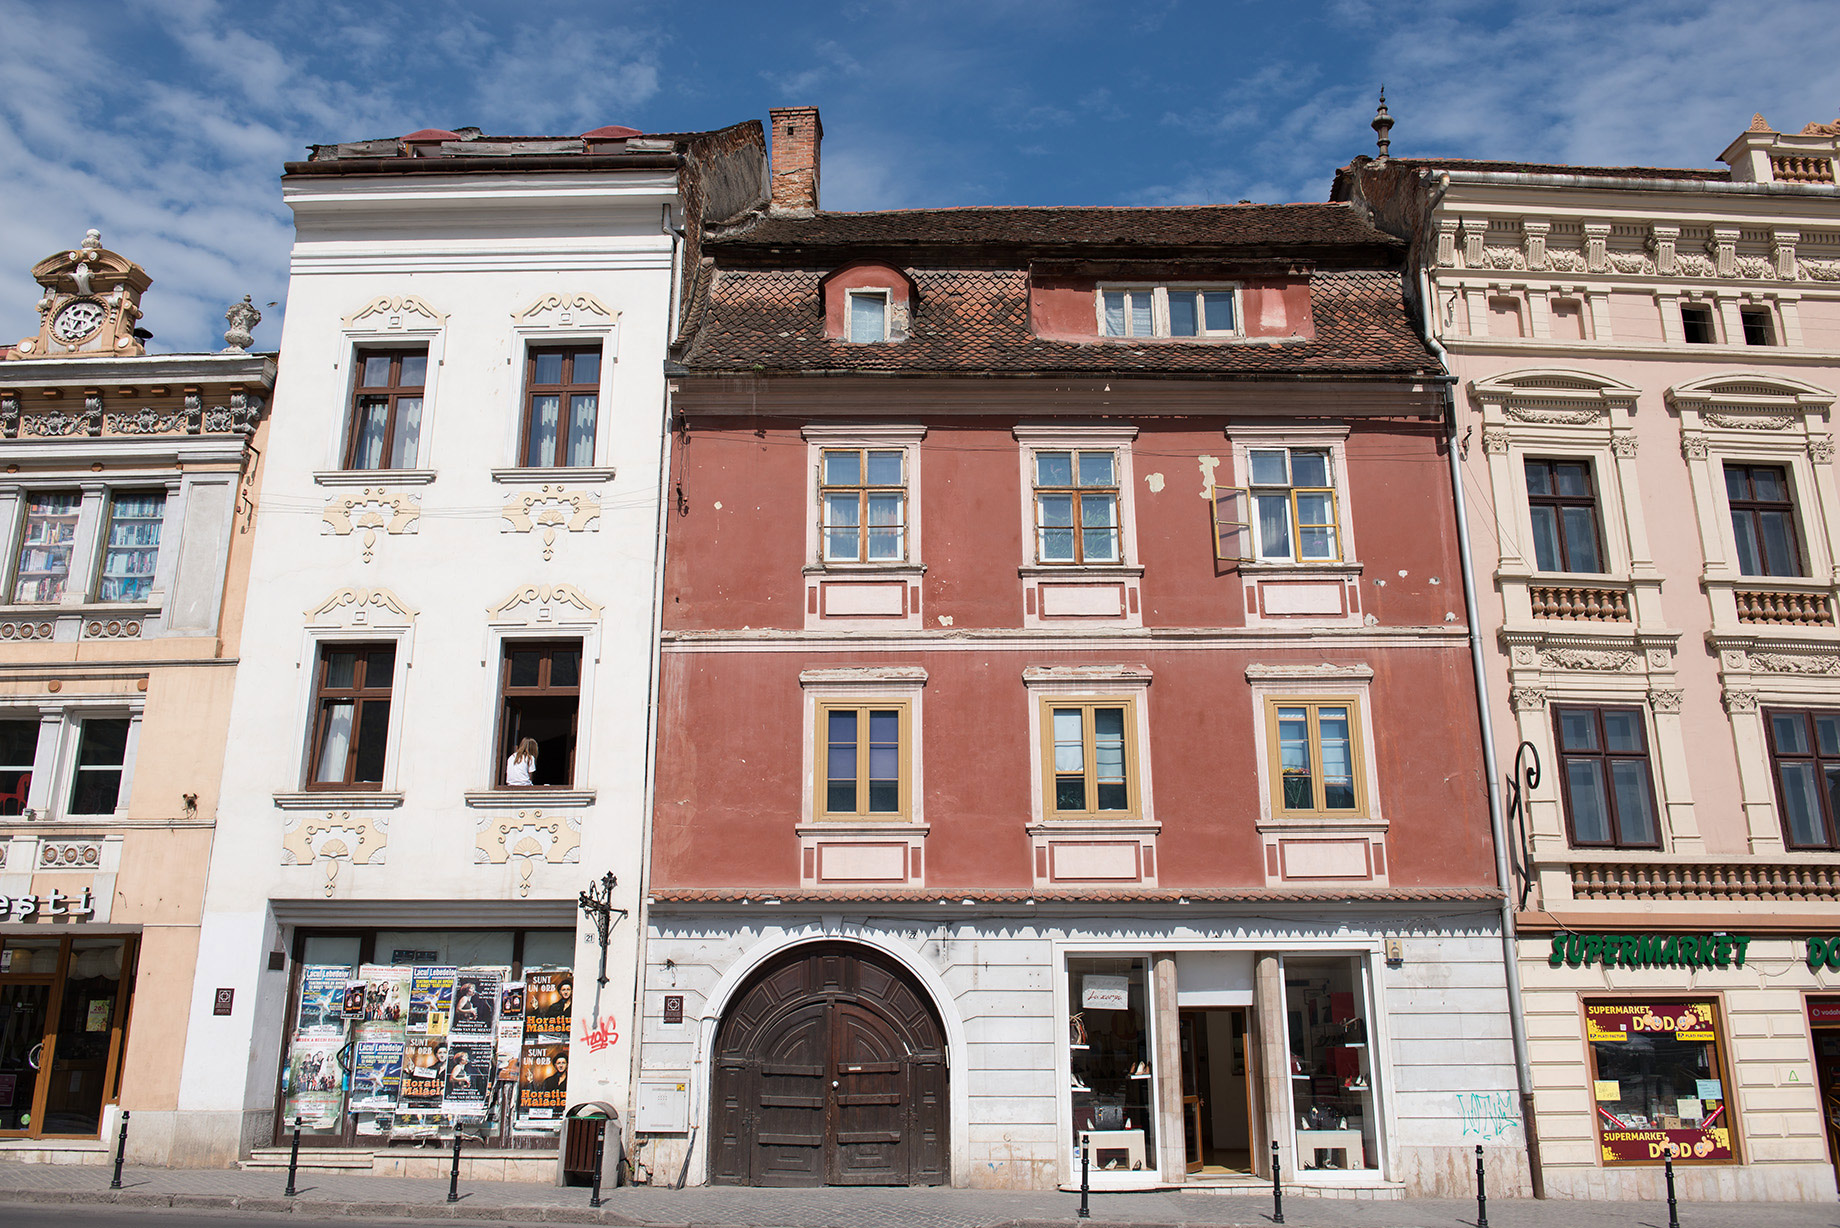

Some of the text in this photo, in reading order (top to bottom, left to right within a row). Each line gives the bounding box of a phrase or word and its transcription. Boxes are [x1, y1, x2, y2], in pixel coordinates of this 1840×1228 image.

[585, 934, 594, 942] 21
[1551, 935, 1751, 965] SUPERMARKET
[413, 968, 429, 976] Lacul
[532, 976, 552, 984] SUNT
[528, 984, 556, 993] UN ORB
[1588, 1005, 1650, 1015] SUPERMARKET
[410, 1038, 429, 1047] SUNT
[405, 1046, 432, 1055] UN ORB
[527, 1048, 548, 1057] SUNT
[523, 1056, 551, 1066] UN ORB
[1603, 1132, 1666, 1141] SUPERMARKET
